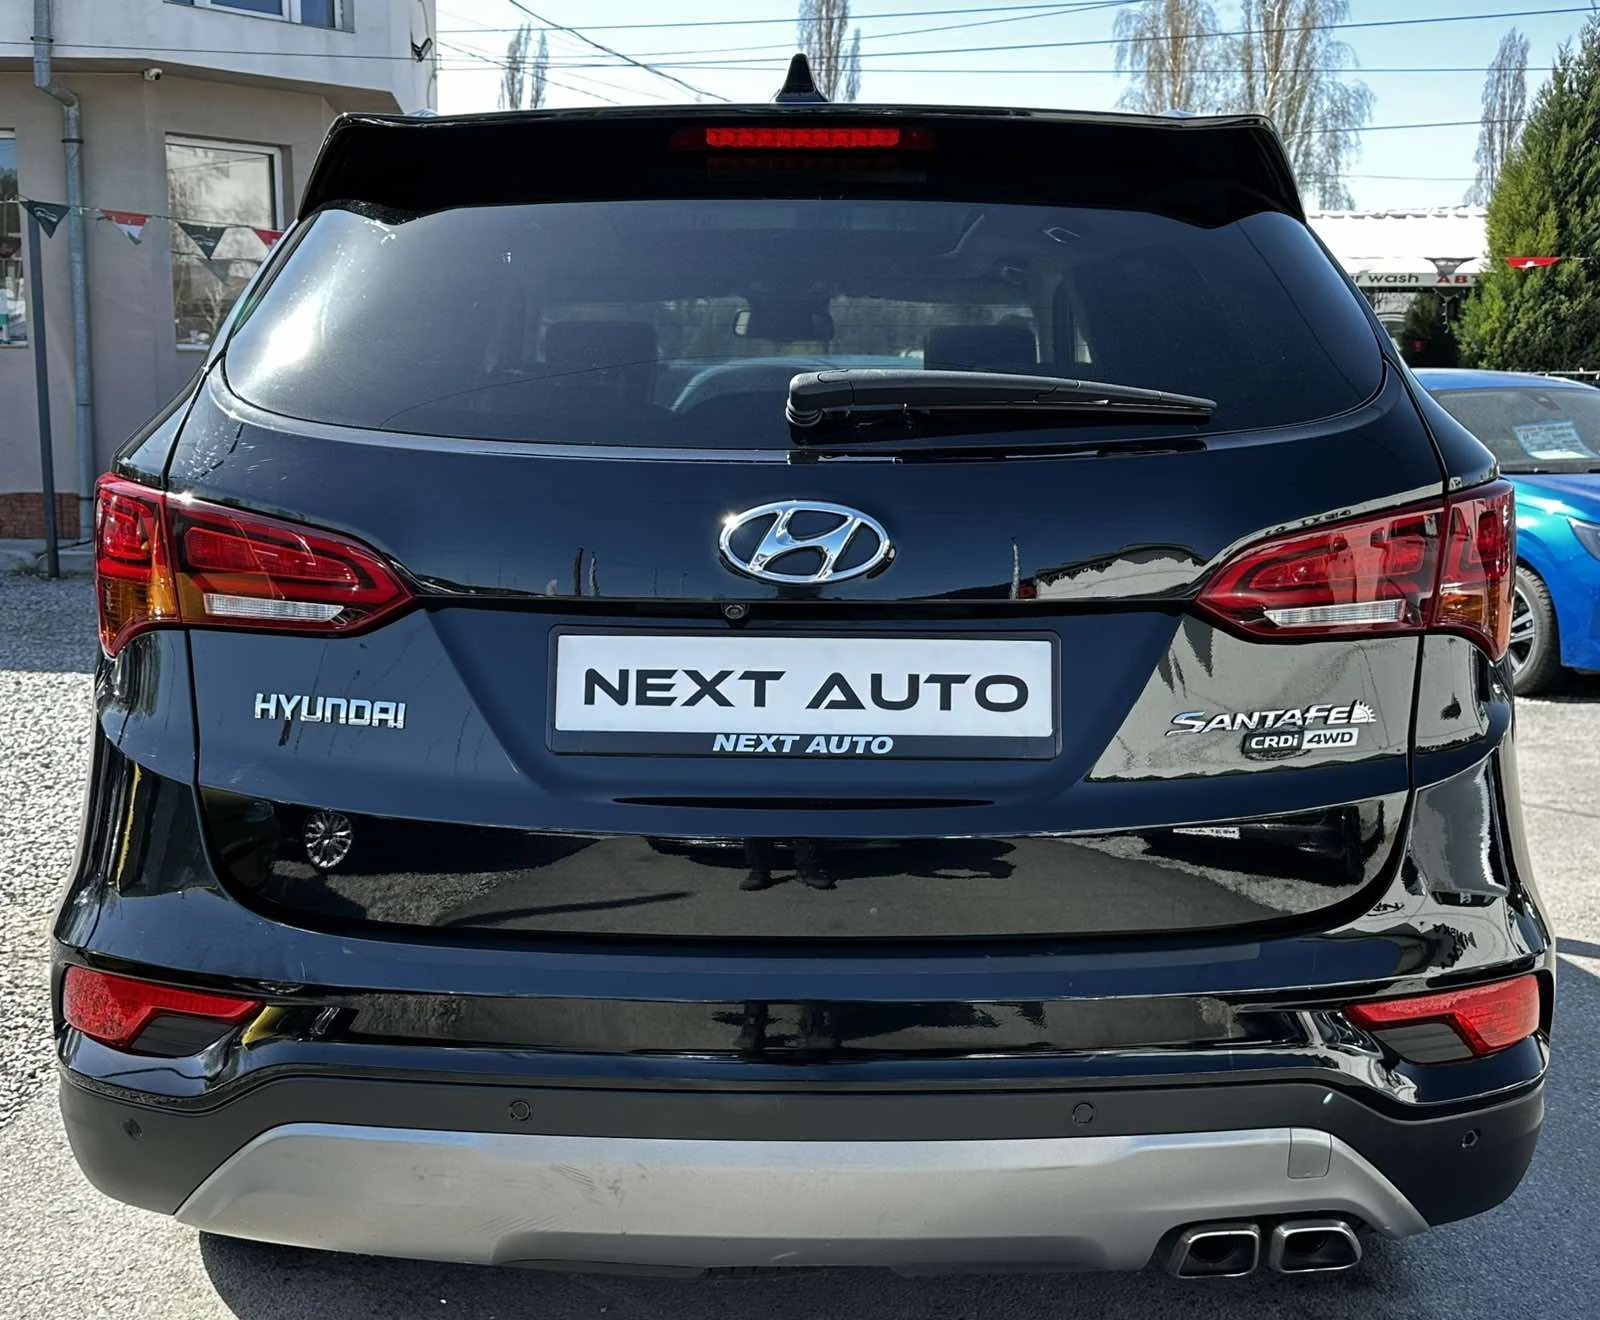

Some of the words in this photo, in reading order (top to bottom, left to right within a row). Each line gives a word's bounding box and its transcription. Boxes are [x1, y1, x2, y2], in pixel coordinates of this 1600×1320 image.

[1368, 273, 1419, 284] wash
[584, 668, 787, 707] NEXT
[805, 671, 1029, 712] AUTO
[254, 693, 406, 729] HYUNDAI
[712, 734, 800, 753] NEXT
[805, 736, 894, 754] AUTO
[1250, 734, 1299, 749] CRDi
[1306, 731, 1354, 745] 4WD
